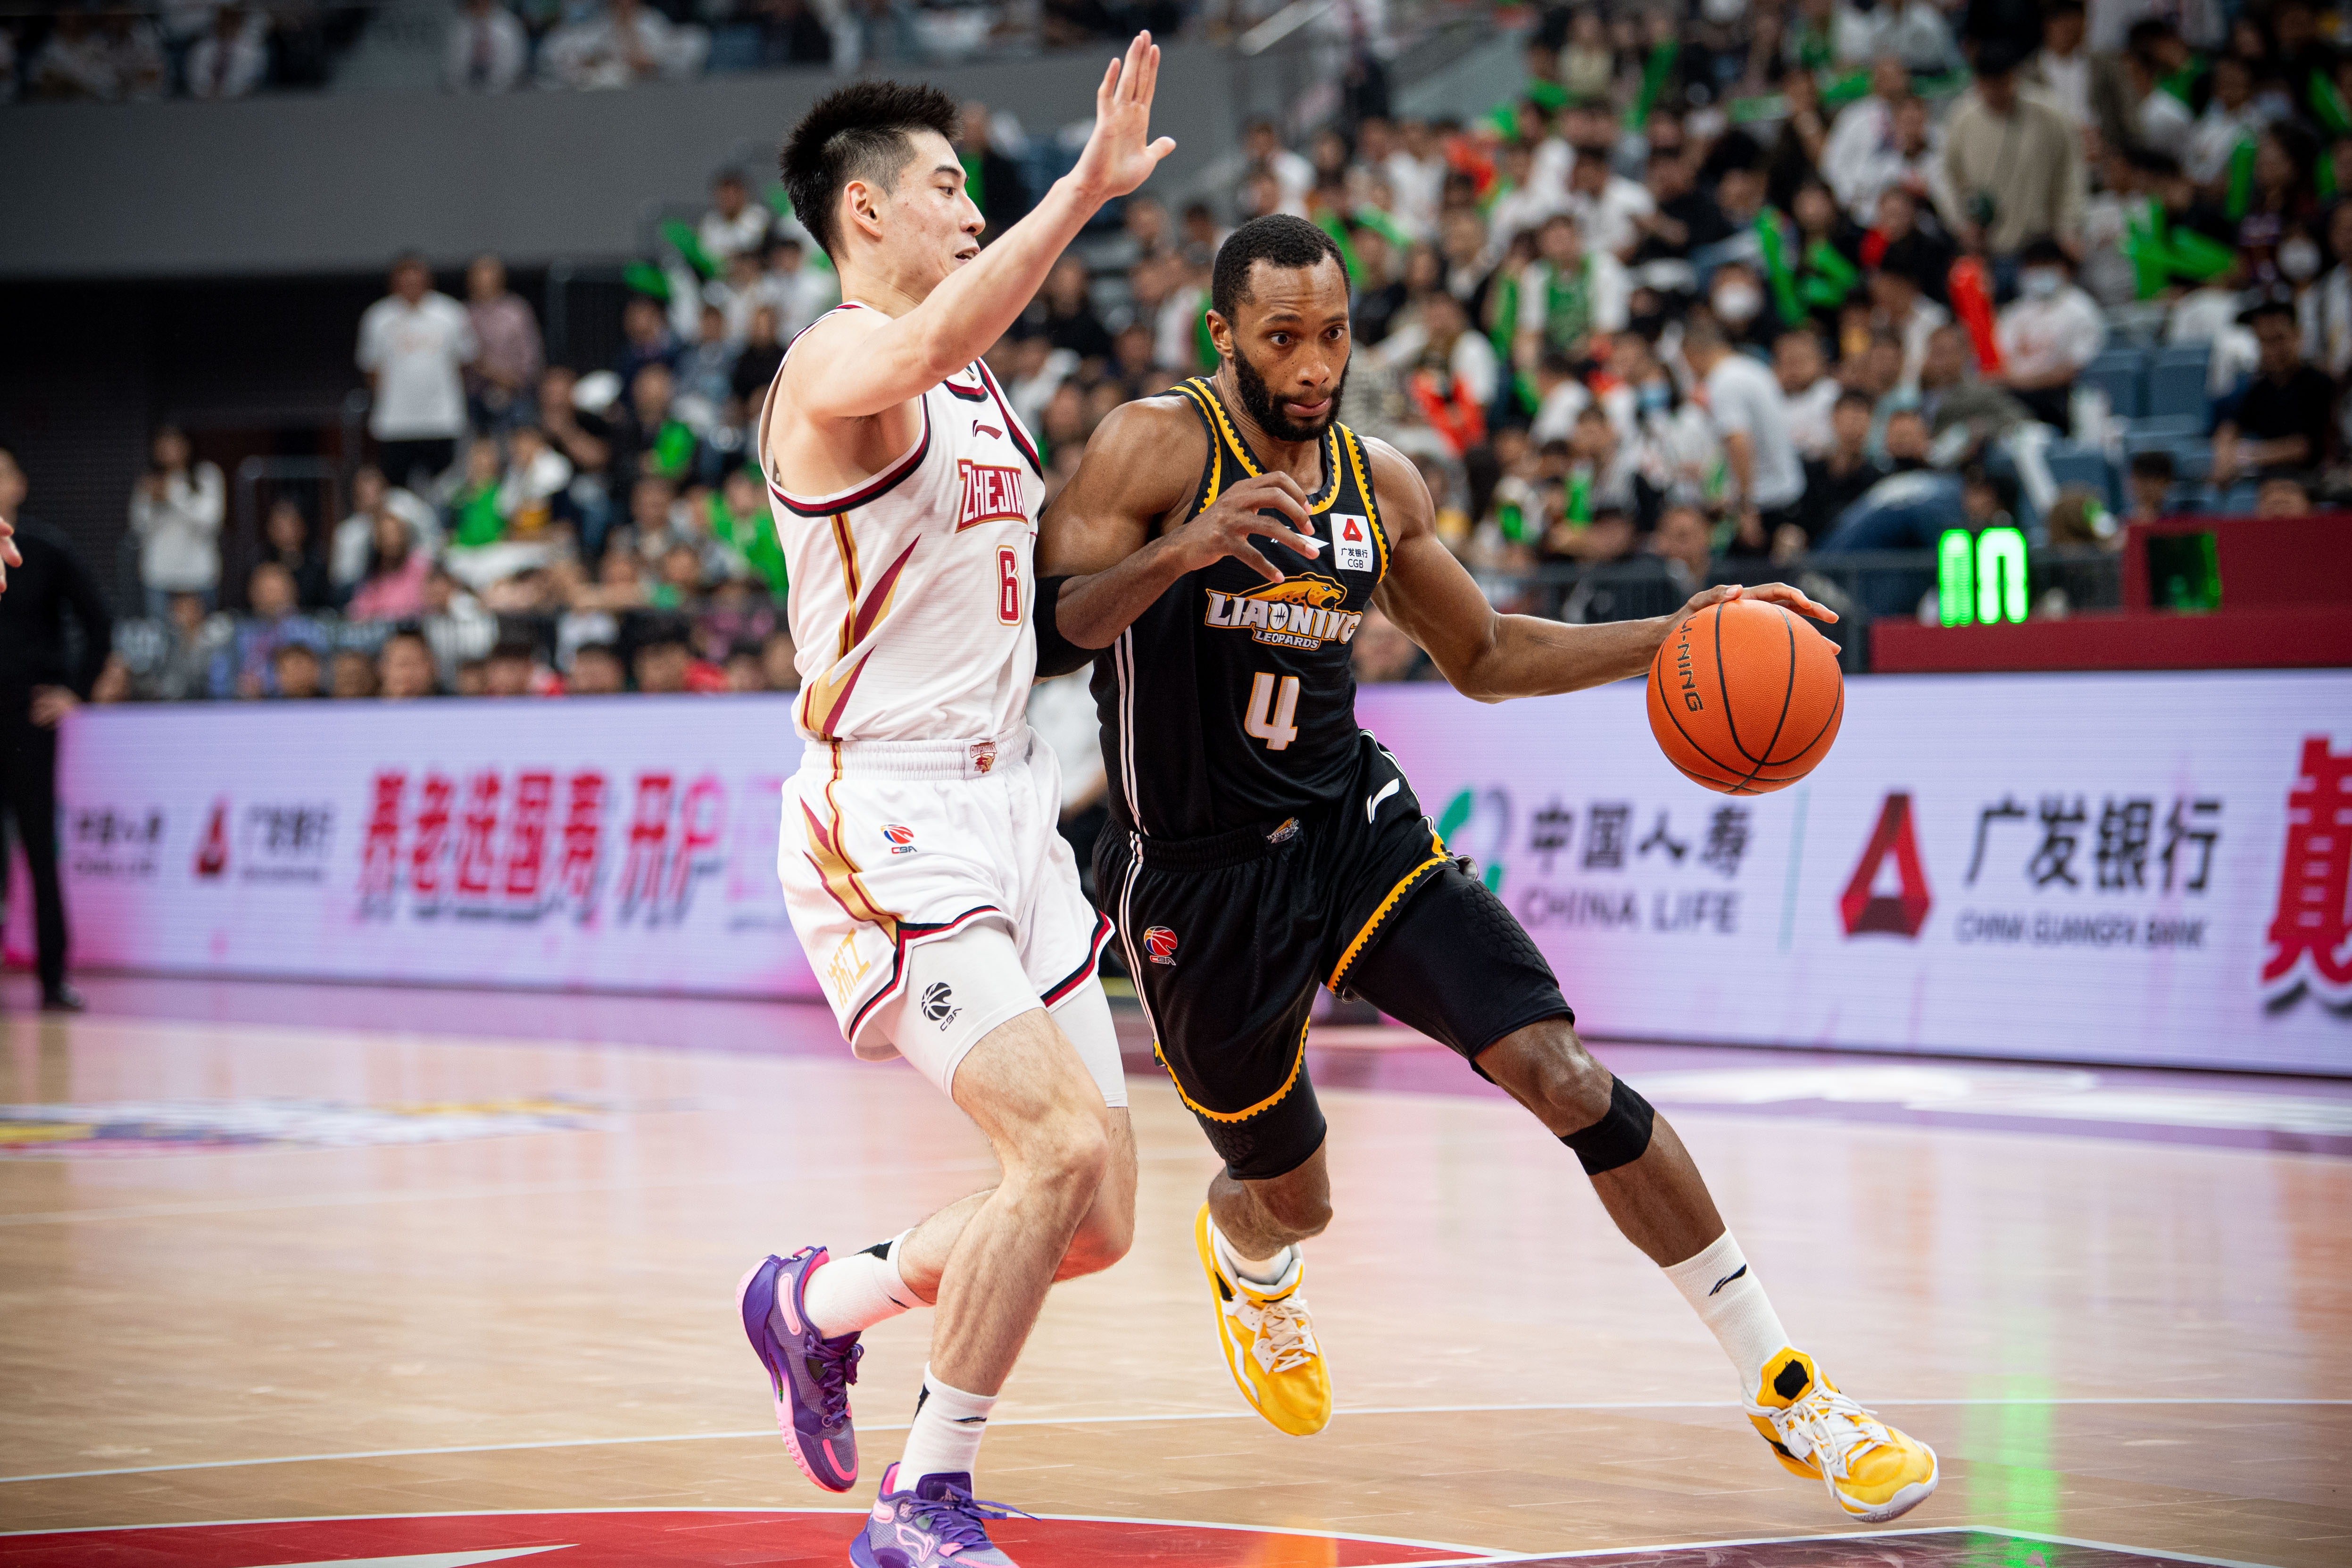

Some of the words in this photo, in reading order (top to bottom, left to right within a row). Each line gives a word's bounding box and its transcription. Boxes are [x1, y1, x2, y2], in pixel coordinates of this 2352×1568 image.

[960, 464, 1028, 524] ZHEJIA
[1340, 548, 1368, 558] 广发银行
[1347, 558, 1364, 569] CGB
[996, 545, 1022, 626] 6
[1205, 591, 1362, 643] LIAONING
[1254, 630, 1320, 649] LEOPARDS
[1245, 672, 1299, 750] 4
[891, 846, 918, 855] CBA
[1530, 796, 1754, 879] 中国人寿
[1965, 790, 2224, 895] 广发银行
[1521, 885, 1637, 930] CHINA
[1651, 889, 1739, 934] LIFE
[1149, 954, 1177, 966] CBA
[940, 1008, 963, 1032] CBA
